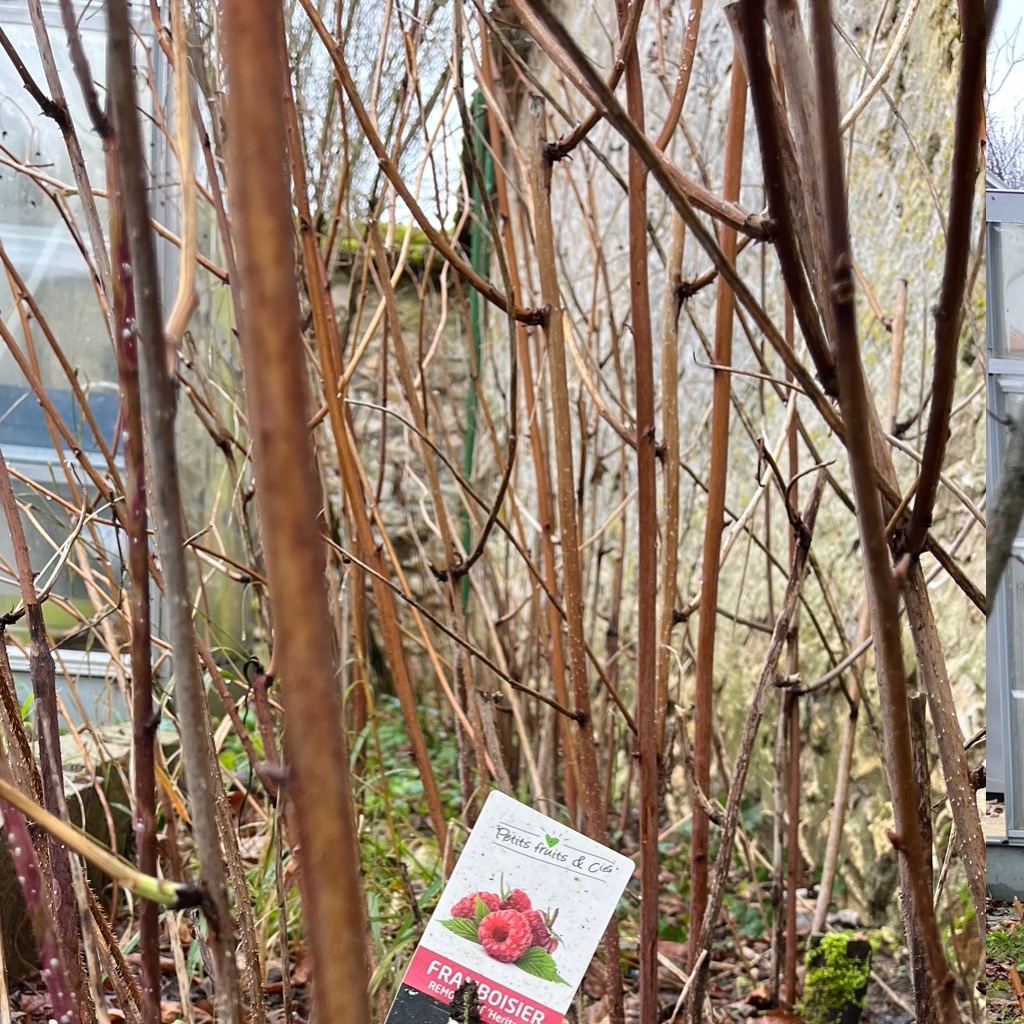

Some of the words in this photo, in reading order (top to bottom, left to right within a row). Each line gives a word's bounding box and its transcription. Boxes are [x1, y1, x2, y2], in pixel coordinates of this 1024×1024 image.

[496, 826, 531, 849] Petits
[534, 842, 569, 862] fruits
[572, 855, 586, 869] &
